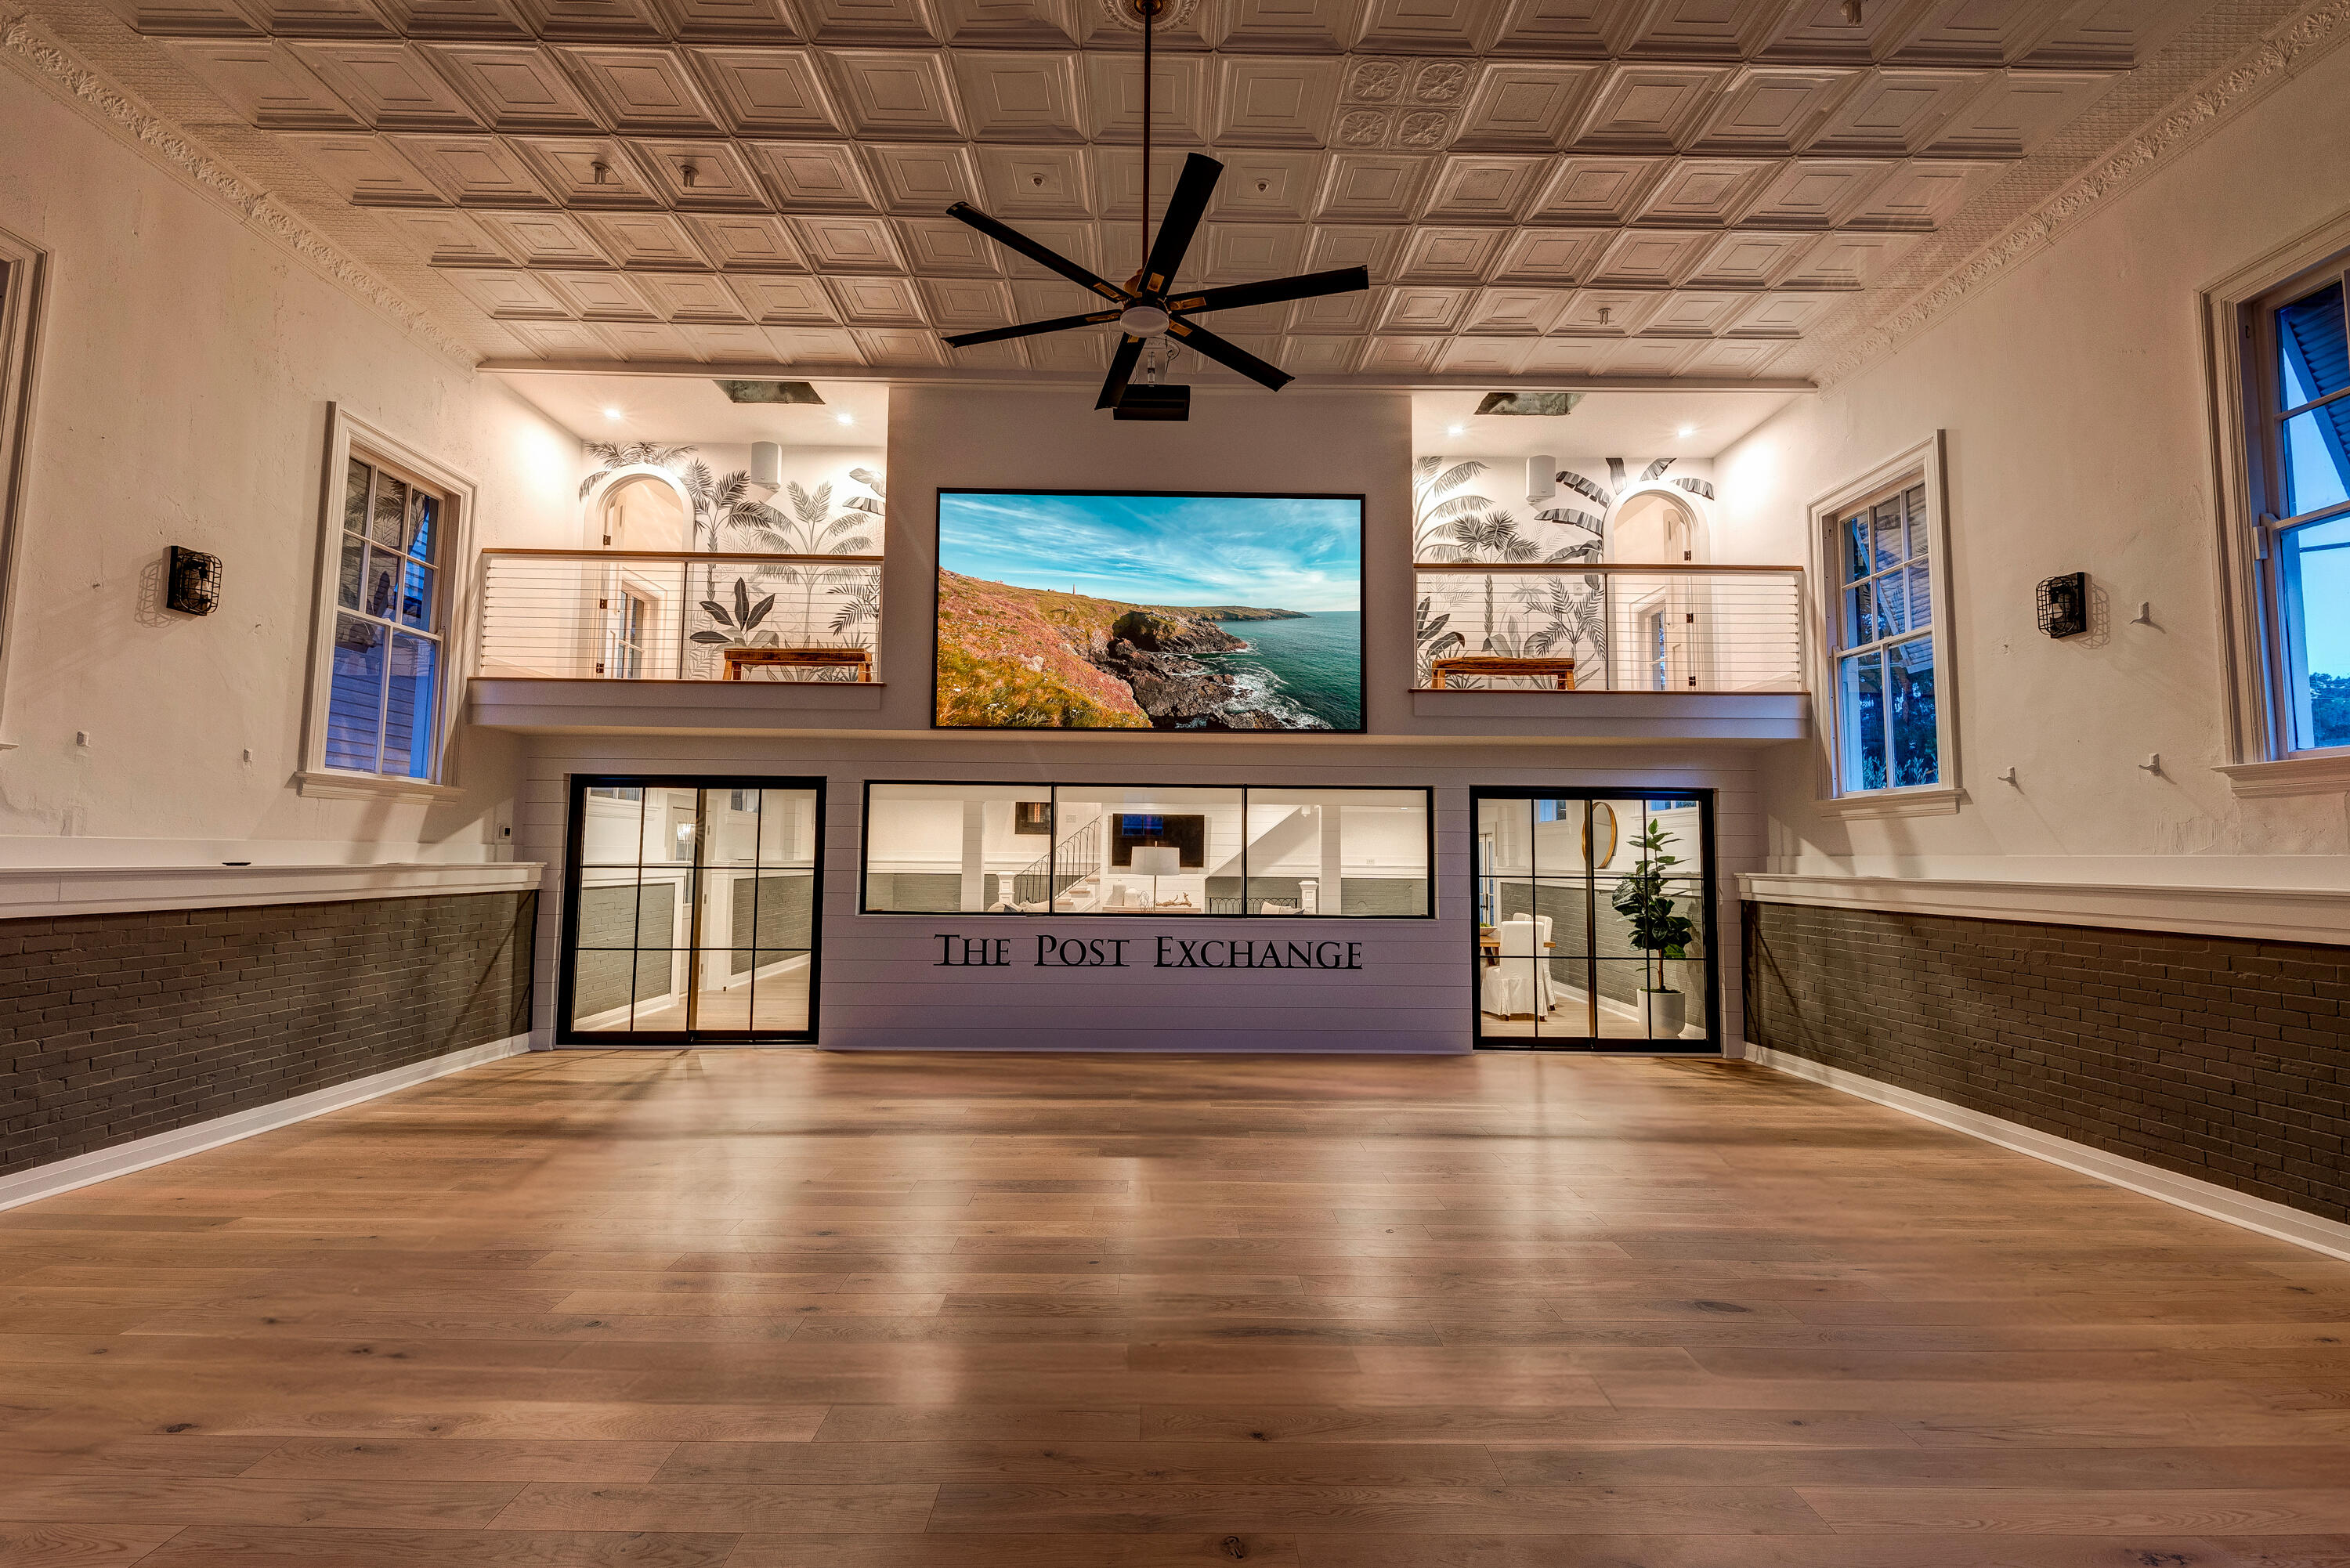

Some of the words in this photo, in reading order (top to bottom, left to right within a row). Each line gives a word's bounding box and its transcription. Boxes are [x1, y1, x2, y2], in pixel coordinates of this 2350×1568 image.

[933, 934, 1010, 966] THE
[1034, 934, 1130, 967] POST
[1154, 936, 1363, 970] EXCHANGE
